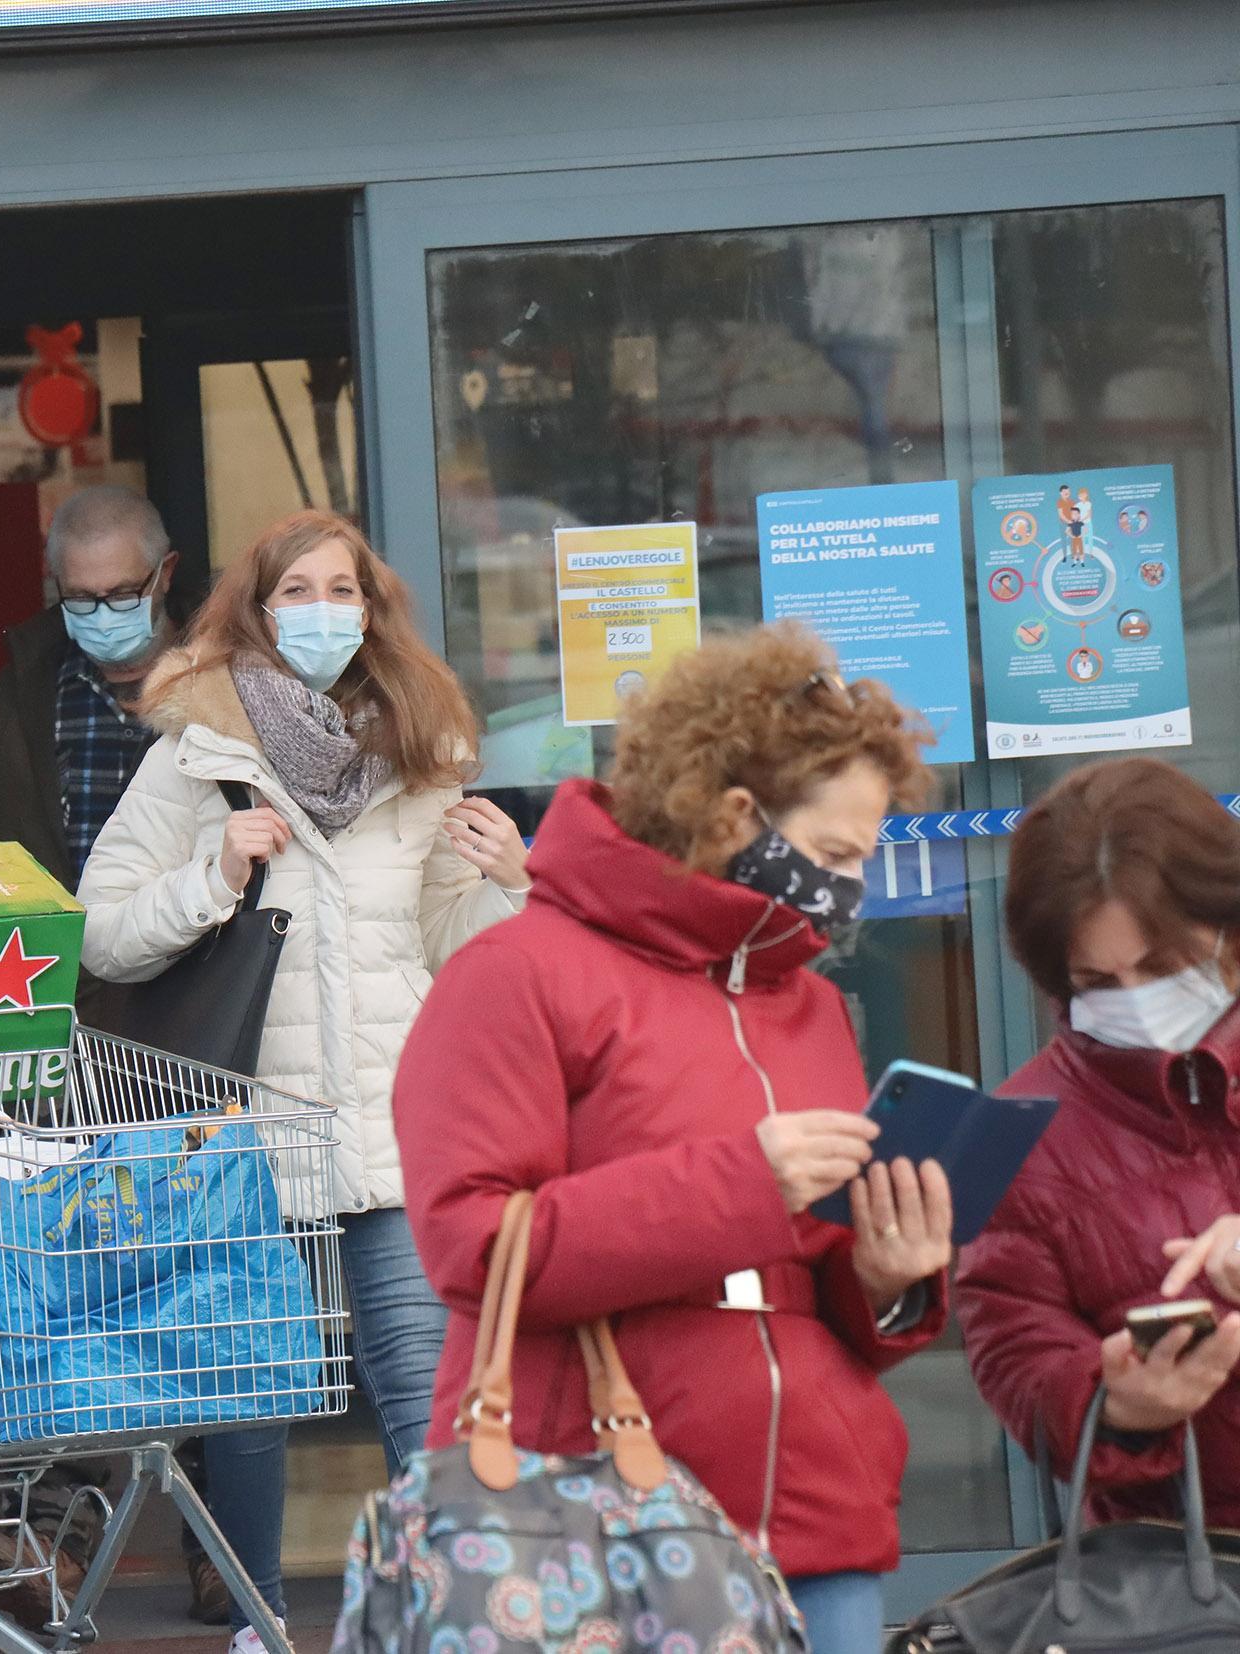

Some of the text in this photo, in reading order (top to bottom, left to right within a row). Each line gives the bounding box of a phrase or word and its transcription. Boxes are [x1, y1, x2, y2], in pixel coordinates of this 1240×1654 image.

[770, 513, 940, 536] COLLABORIAMO INSIEME
[770, 532, 878, 550] PER LA TUTELA
[571, 551, 681, 567] #LENUOVEREGOLE
[771, 542, 935, 564] DELLA NOSTRA SALUTE
[596, 585, 666, 597] IL CASTELLO
[598, 600, 658, 610] CONSENTITO
